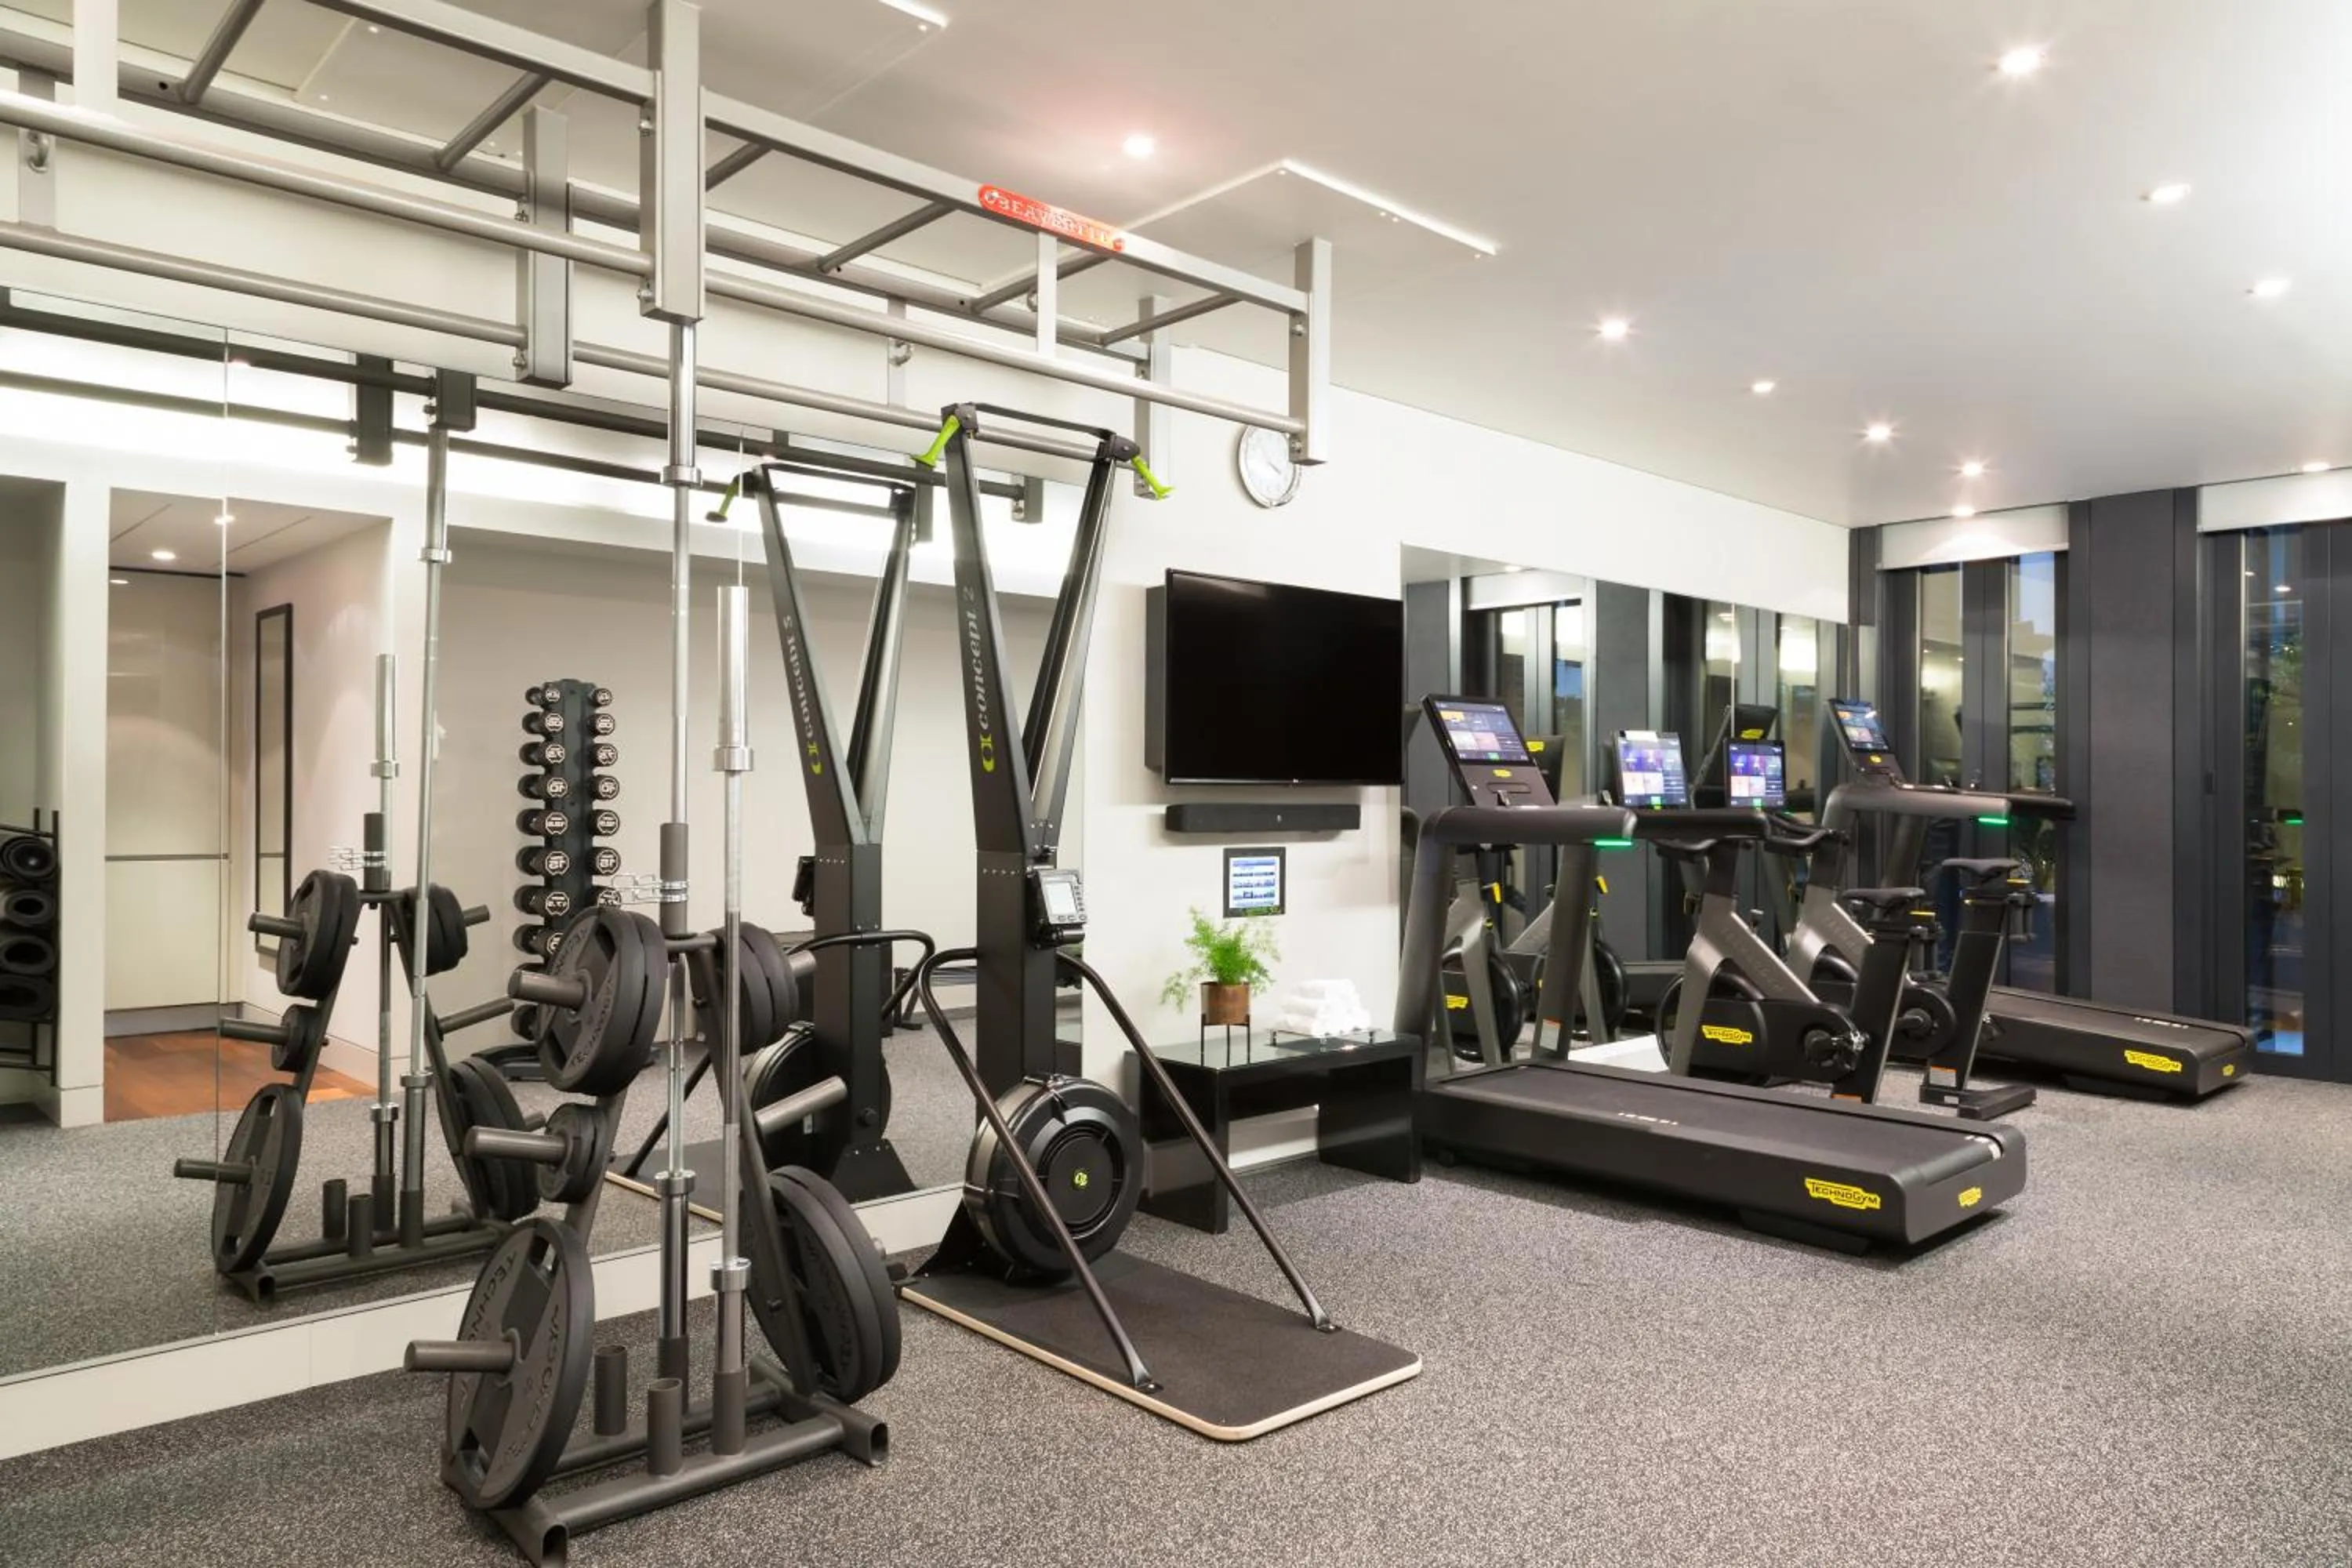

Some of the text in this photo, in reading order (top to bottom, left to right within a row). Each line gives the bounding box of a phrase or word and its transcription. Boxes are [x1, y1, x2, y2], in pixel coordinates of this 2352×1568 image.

[963, 586, 989, 730] concept 2
[1809, 1182, 1878, 1205] TECHNOGYM
